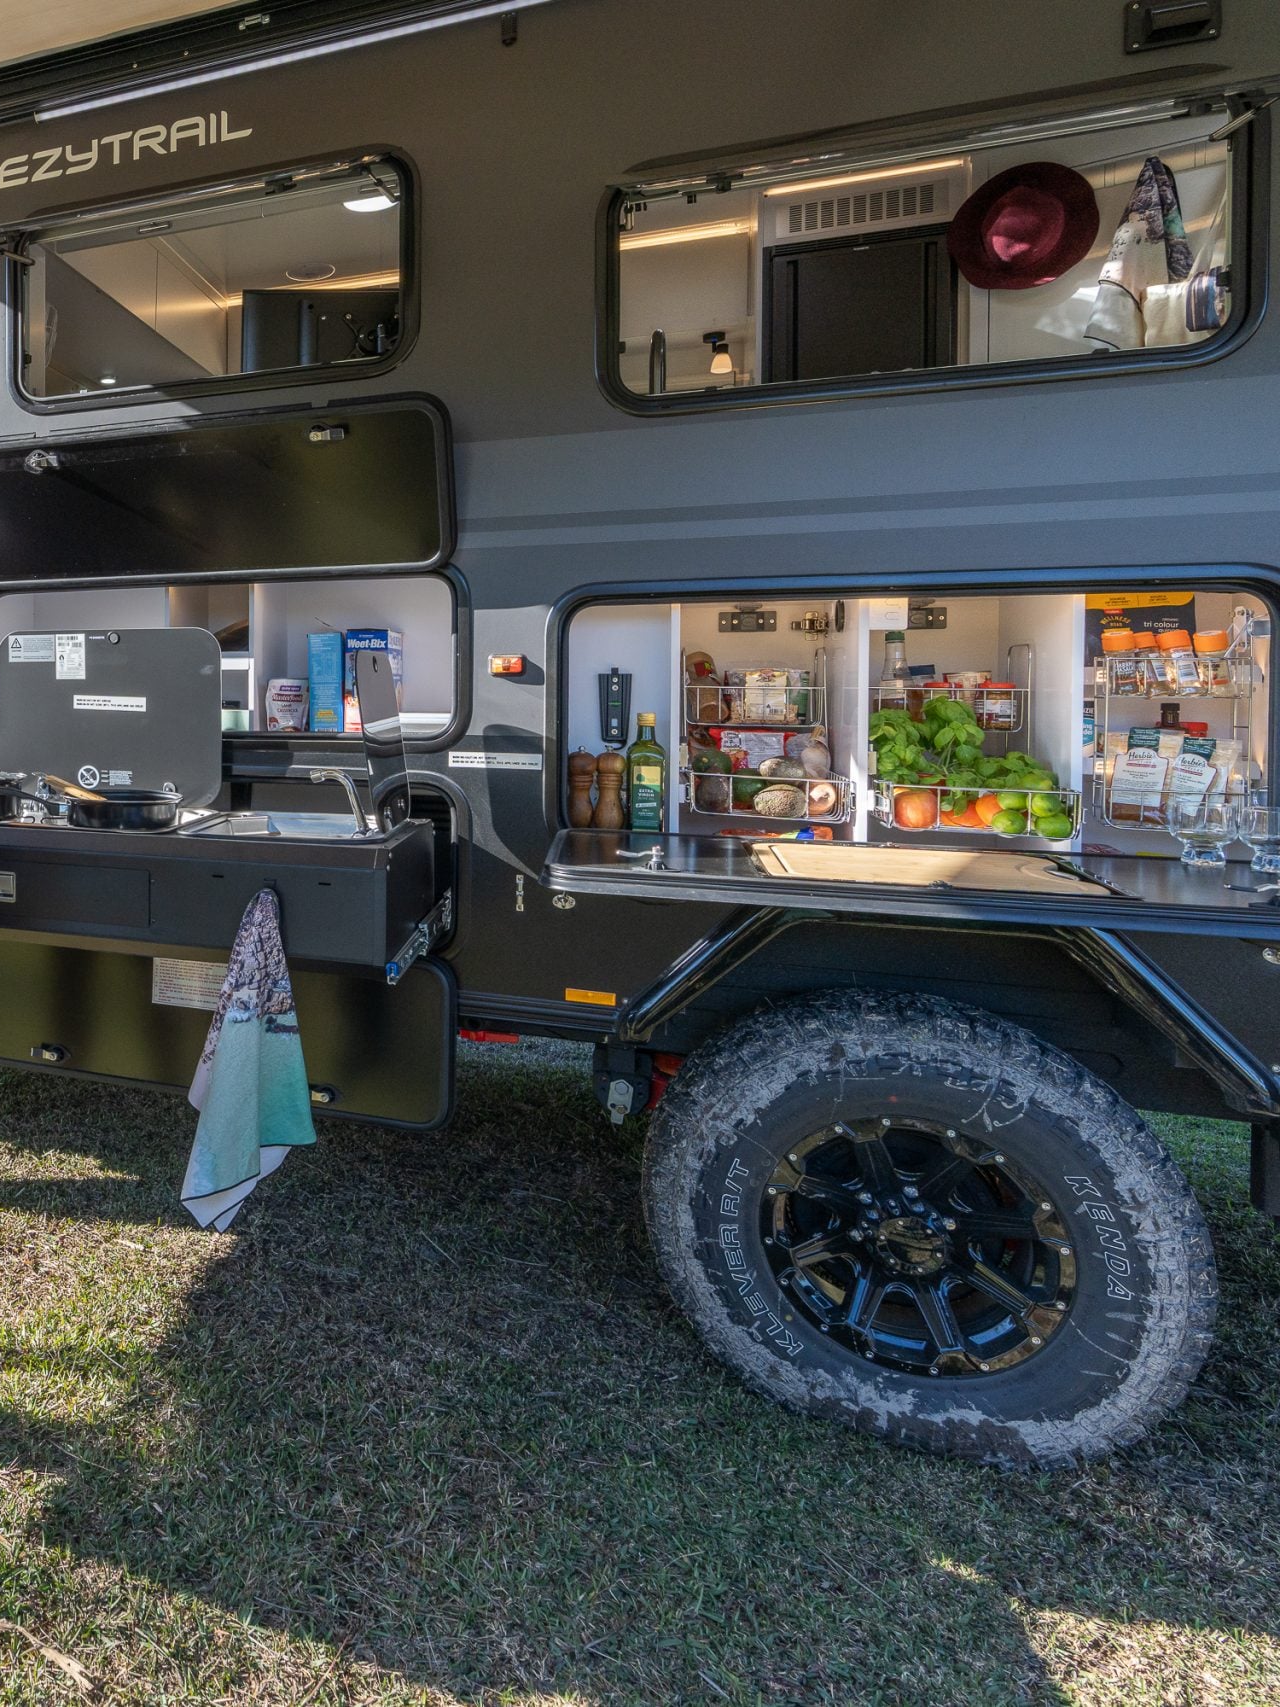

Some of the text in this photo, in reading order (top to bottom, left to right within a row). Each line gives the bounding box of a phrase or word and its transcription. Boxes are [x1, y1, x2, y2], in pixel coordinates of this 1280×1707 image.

[347, 638, 387, 649] Weet-Bix
[1143, 620, 1152, 628] tri
[1063, 1175, 1133, 1301] KENDA
[719, 1223, 805, 1357] KLEVER
